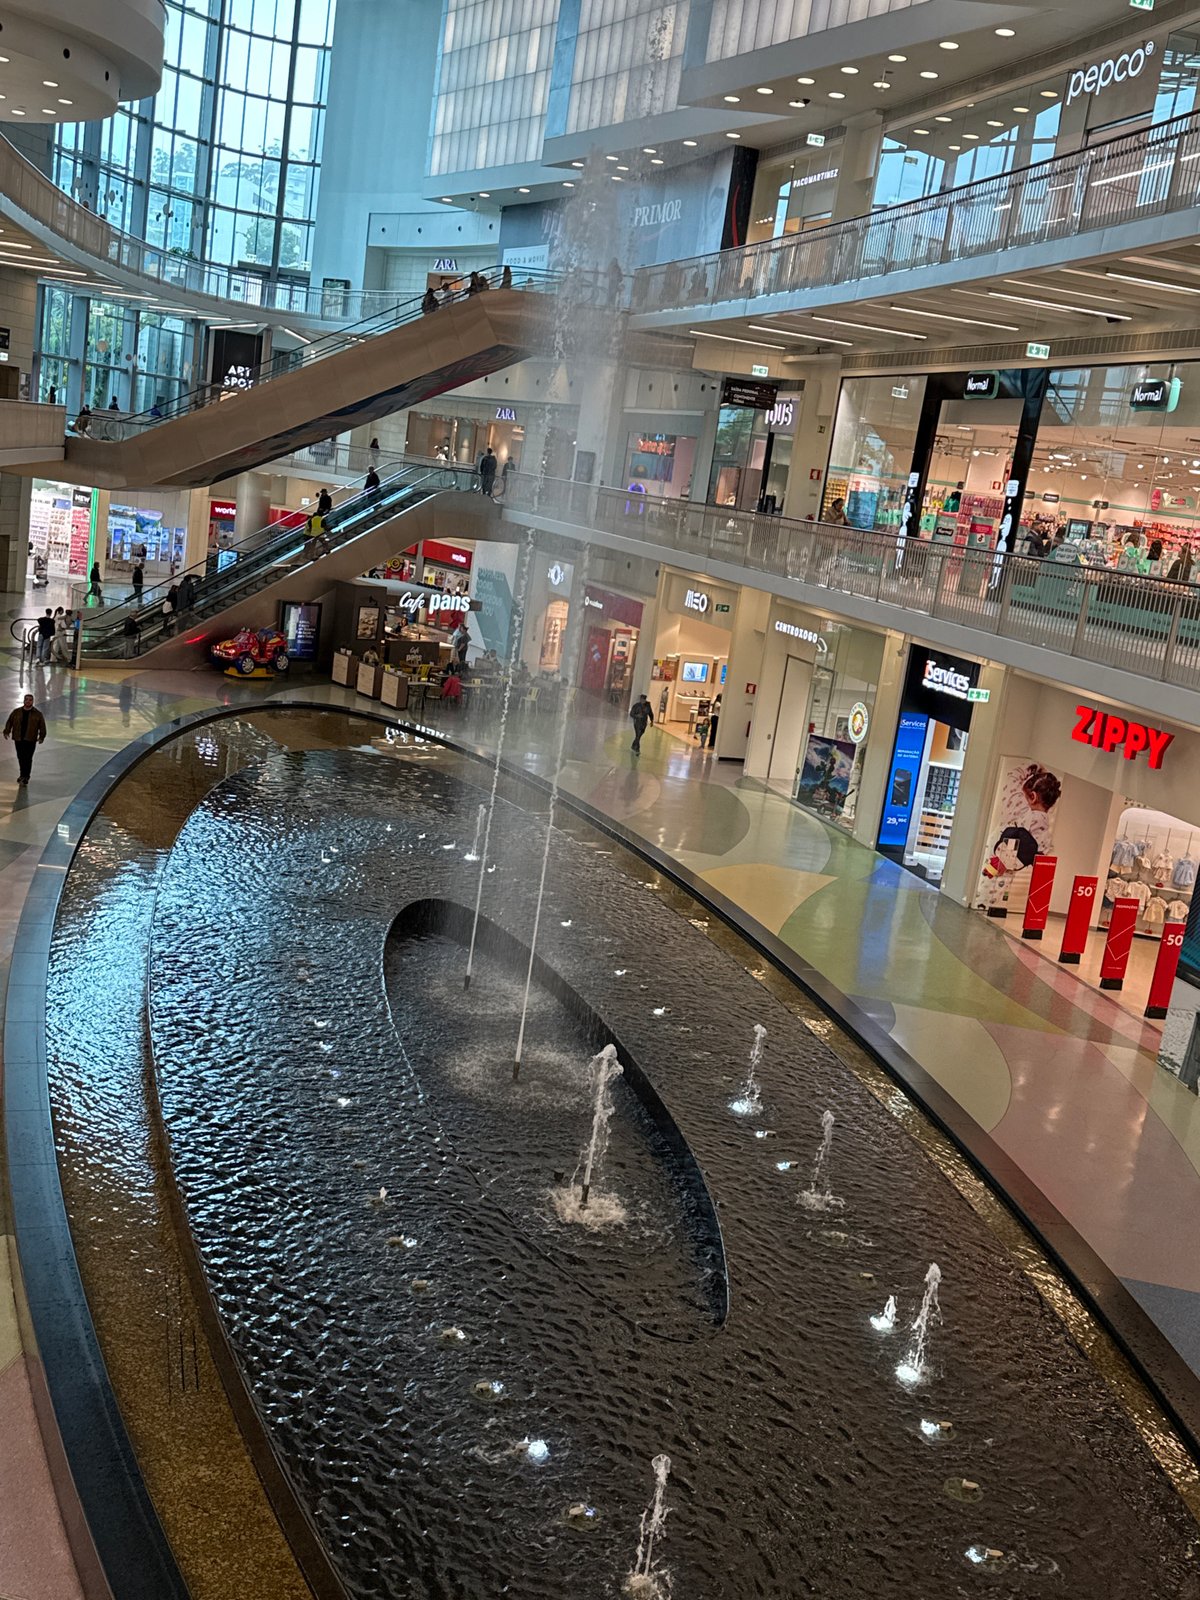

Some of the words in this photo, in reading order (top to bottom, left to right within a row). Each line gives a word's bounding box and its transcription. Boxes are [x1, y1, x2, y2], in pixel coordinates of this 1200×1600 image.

[633, 200, 682, 228] PRIMOR
[433, 258, 458, 271] ZARA
[228, 365, 252, 378] ART
[223, 376, 254, 390] SPOT
[967, 377, 989, 391] Normal
[1133, 386, 1163, 402] Normal
[495, 407, 516, 421] ZARA
[75, 494, 91, 503] NEW
[428, 593, 471, 615] pans
[684, 589, 708, 613] MEO
[775, 620, 818, 644] CENTROXOGO
[924, 660, 969, 692] iServices
[901, 719, 926, 729] iServices
[1071, 705, 1174, 770] ZIPPY
